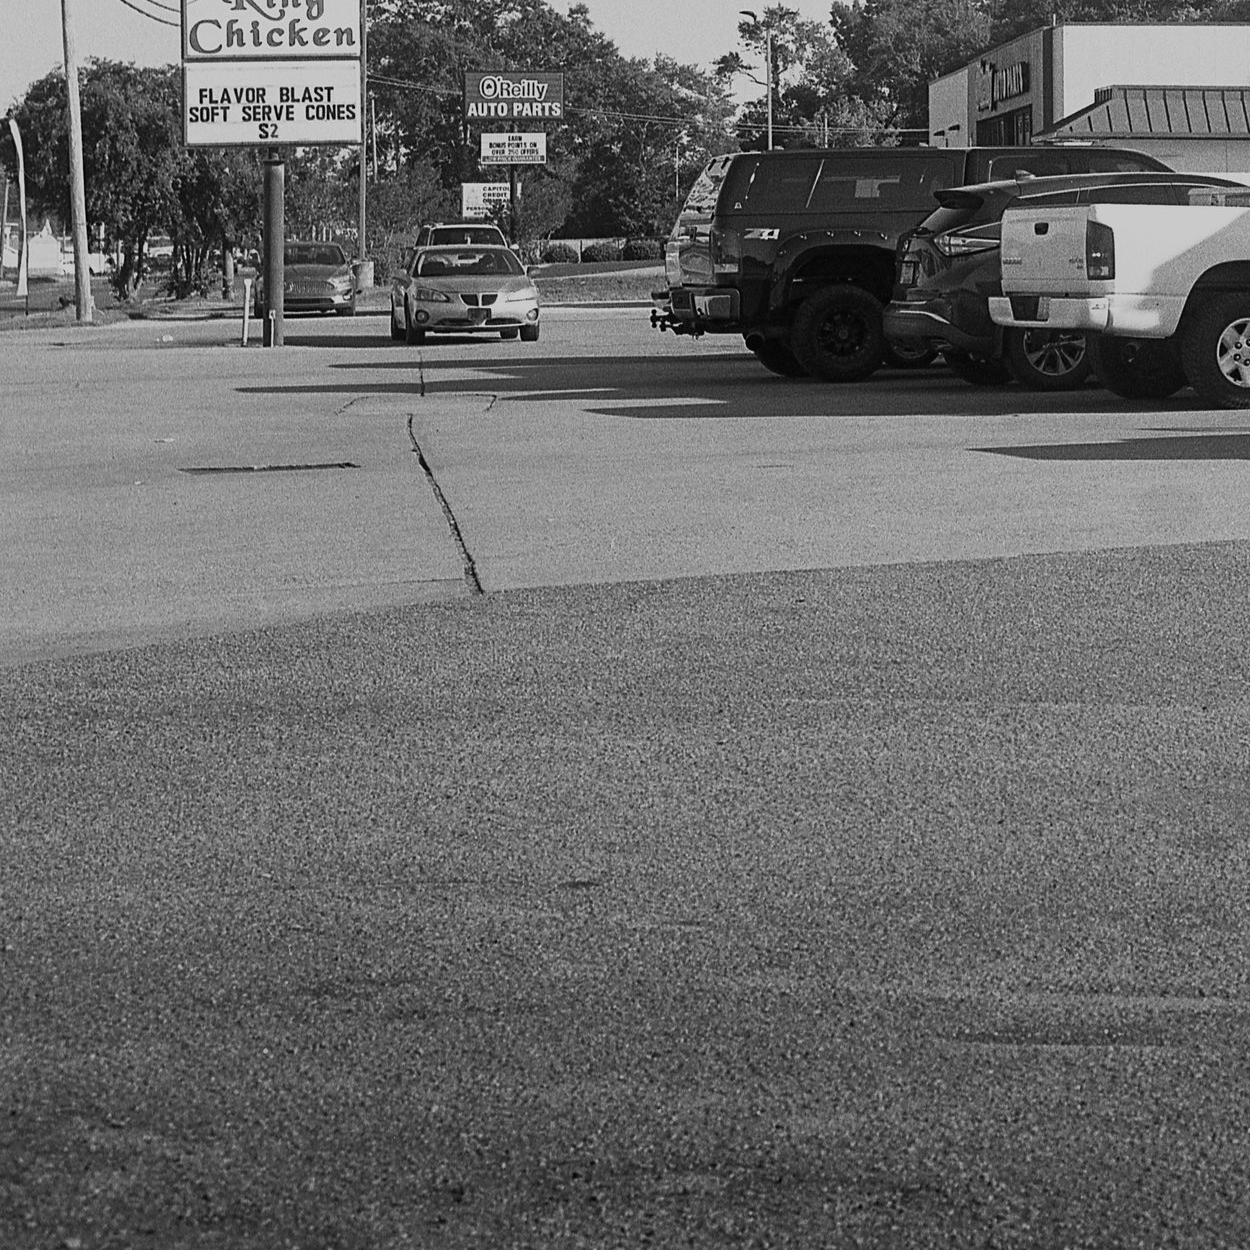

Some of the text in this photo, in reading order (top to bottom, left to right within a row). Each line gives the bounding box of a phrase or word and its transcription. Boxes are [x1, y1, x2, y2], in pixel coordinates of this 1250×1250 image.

[189, 18, 356, 54] Chicken
[199, 86, 335, 105] FLAVOR BLAST
[480, 75, 549, 102] O'Reilly
[189, 103, 357, 123] SOFT SERVE CONES
[467, 102, 561, 117] AUTO PARTS
